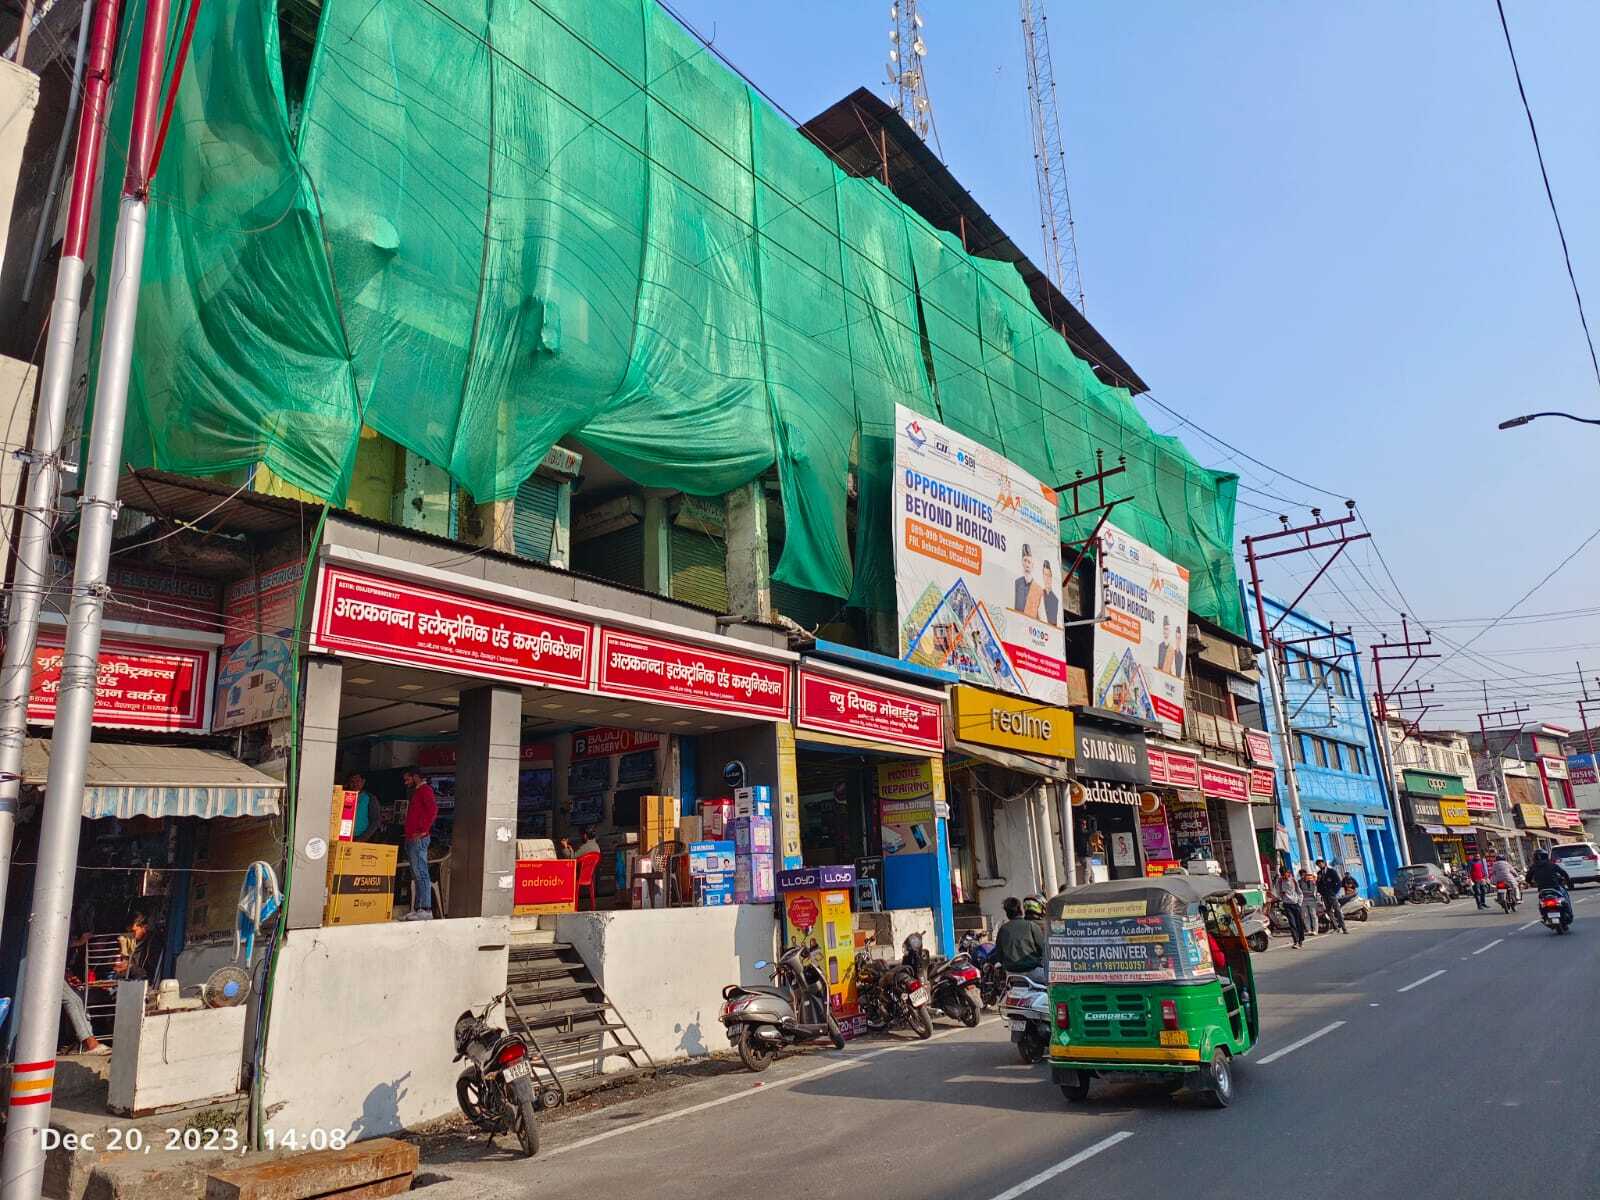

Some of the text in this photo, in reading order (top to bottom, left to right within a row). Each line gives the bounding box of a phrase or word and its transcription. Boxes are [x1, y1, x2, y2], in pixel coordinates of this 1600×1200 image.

[964, 455, 976, 469] SBI
[905, 469, 993, 524] OPPORTUNITIES
[905, 494, 1007, 553] BEYOND HORIZONS
[1127, 596, 1155, 624] HORIZONS
[334, 596, 414, 630] अलकनन्दा
[491, 623, 510, 649] एंड
[512, 630, 584, 662] कम्युनिकेशन
[610, 651, 664, 676] अलकनन्दा
[717, 667, 730, 688] एंड
[731, 672, 782, 697] कम्युनिकेशन
[847, 690, 877, 713] दिपक
[991, 707, 1053, 740] realme
[588, 733, 620, 745] BAJAJ
[588, 741, 620, 754] FINSERV
[1082, 737, 1137, 765] SAMSUNG
[881, 781, 929, 796] REPAIRING
[1085, 782, 1142, 806] addiction
[782, 875, 815, 887] LLOYD
[824, 872, 852, 883] LLOYD
[1066, 927, 1086, 937] Doon
